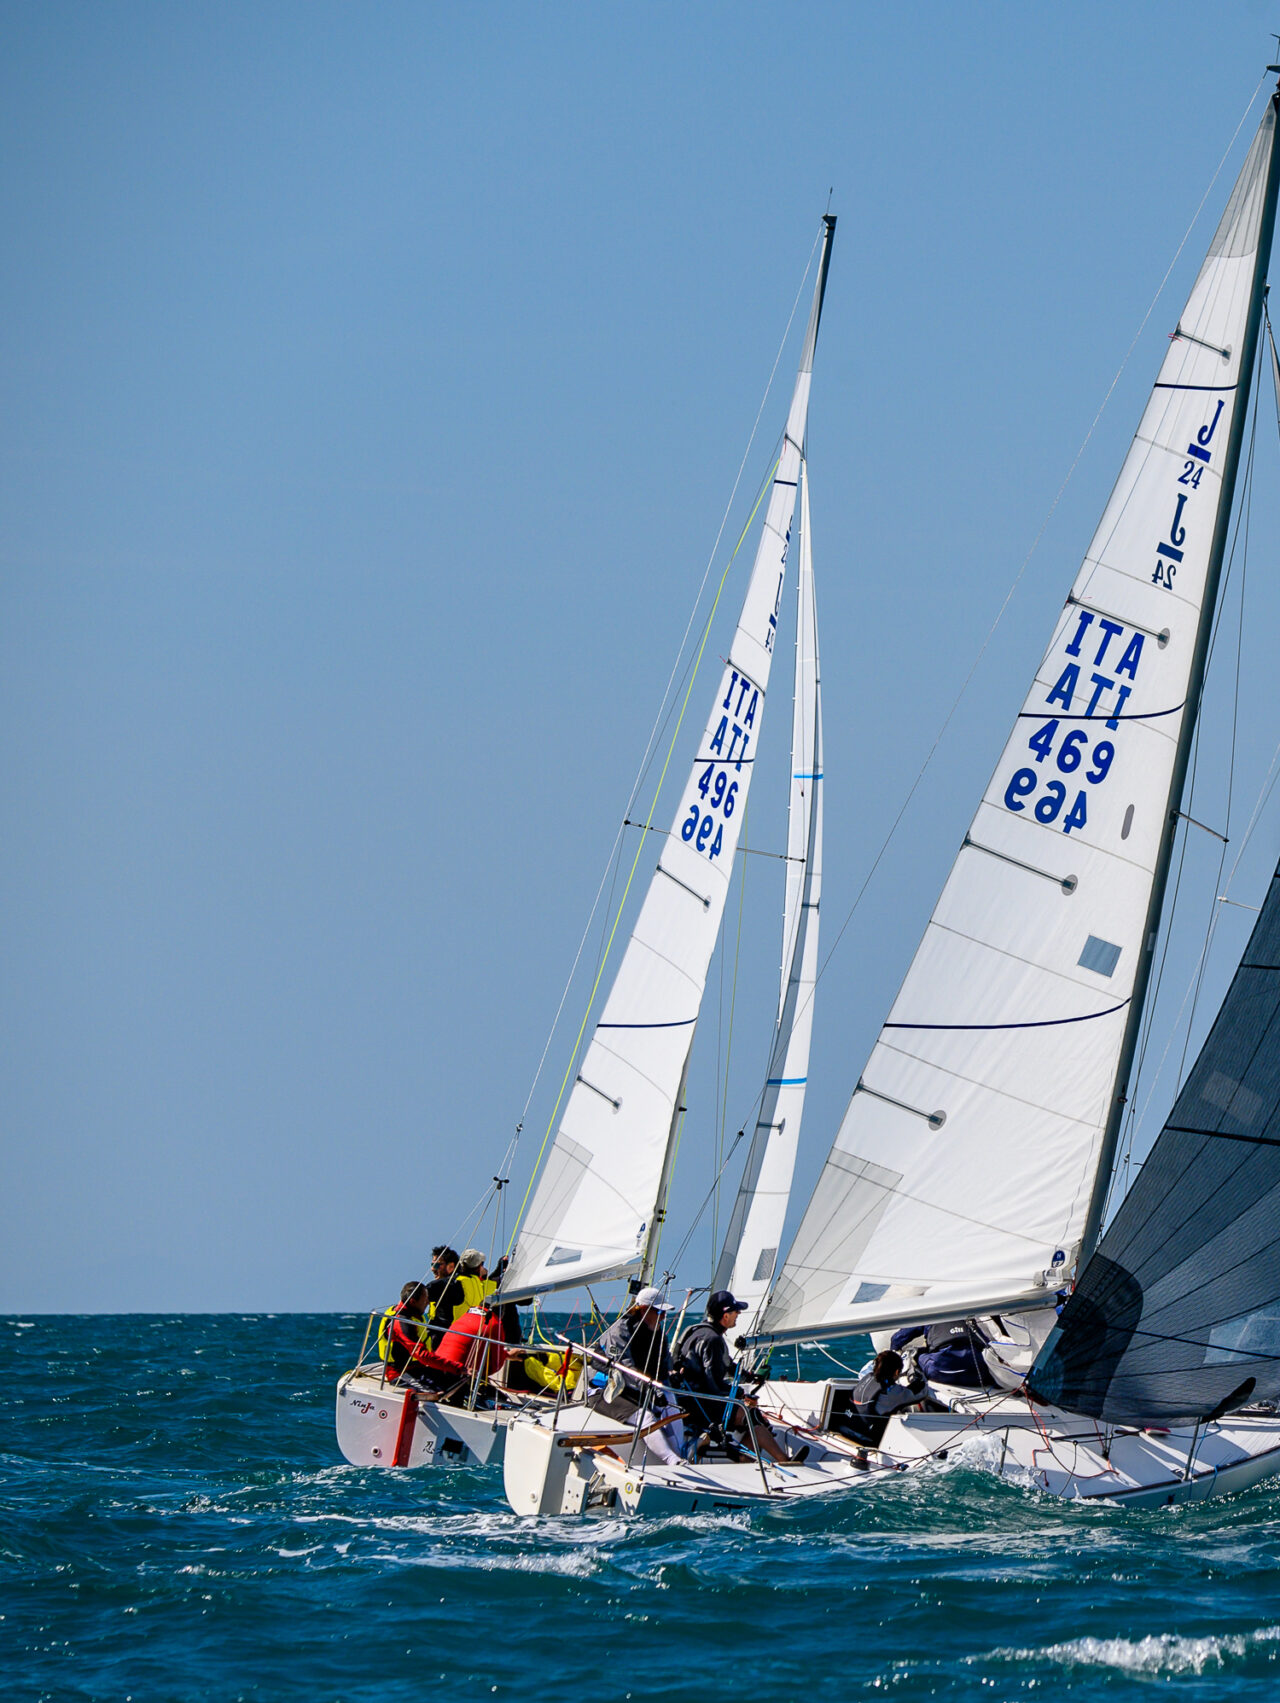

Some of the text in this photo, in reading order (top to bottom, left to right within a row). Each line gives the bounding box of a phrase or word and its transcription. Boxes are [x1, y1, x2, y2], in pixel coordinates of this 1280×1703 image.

[1178, 460, 1204, 490] 24
[1064, 610, 1145, 681] ITA
[722, 670, 759, 730] ITA
[1028, 718, 1115, 785] 469
[698, 761, 739, 819] 496
